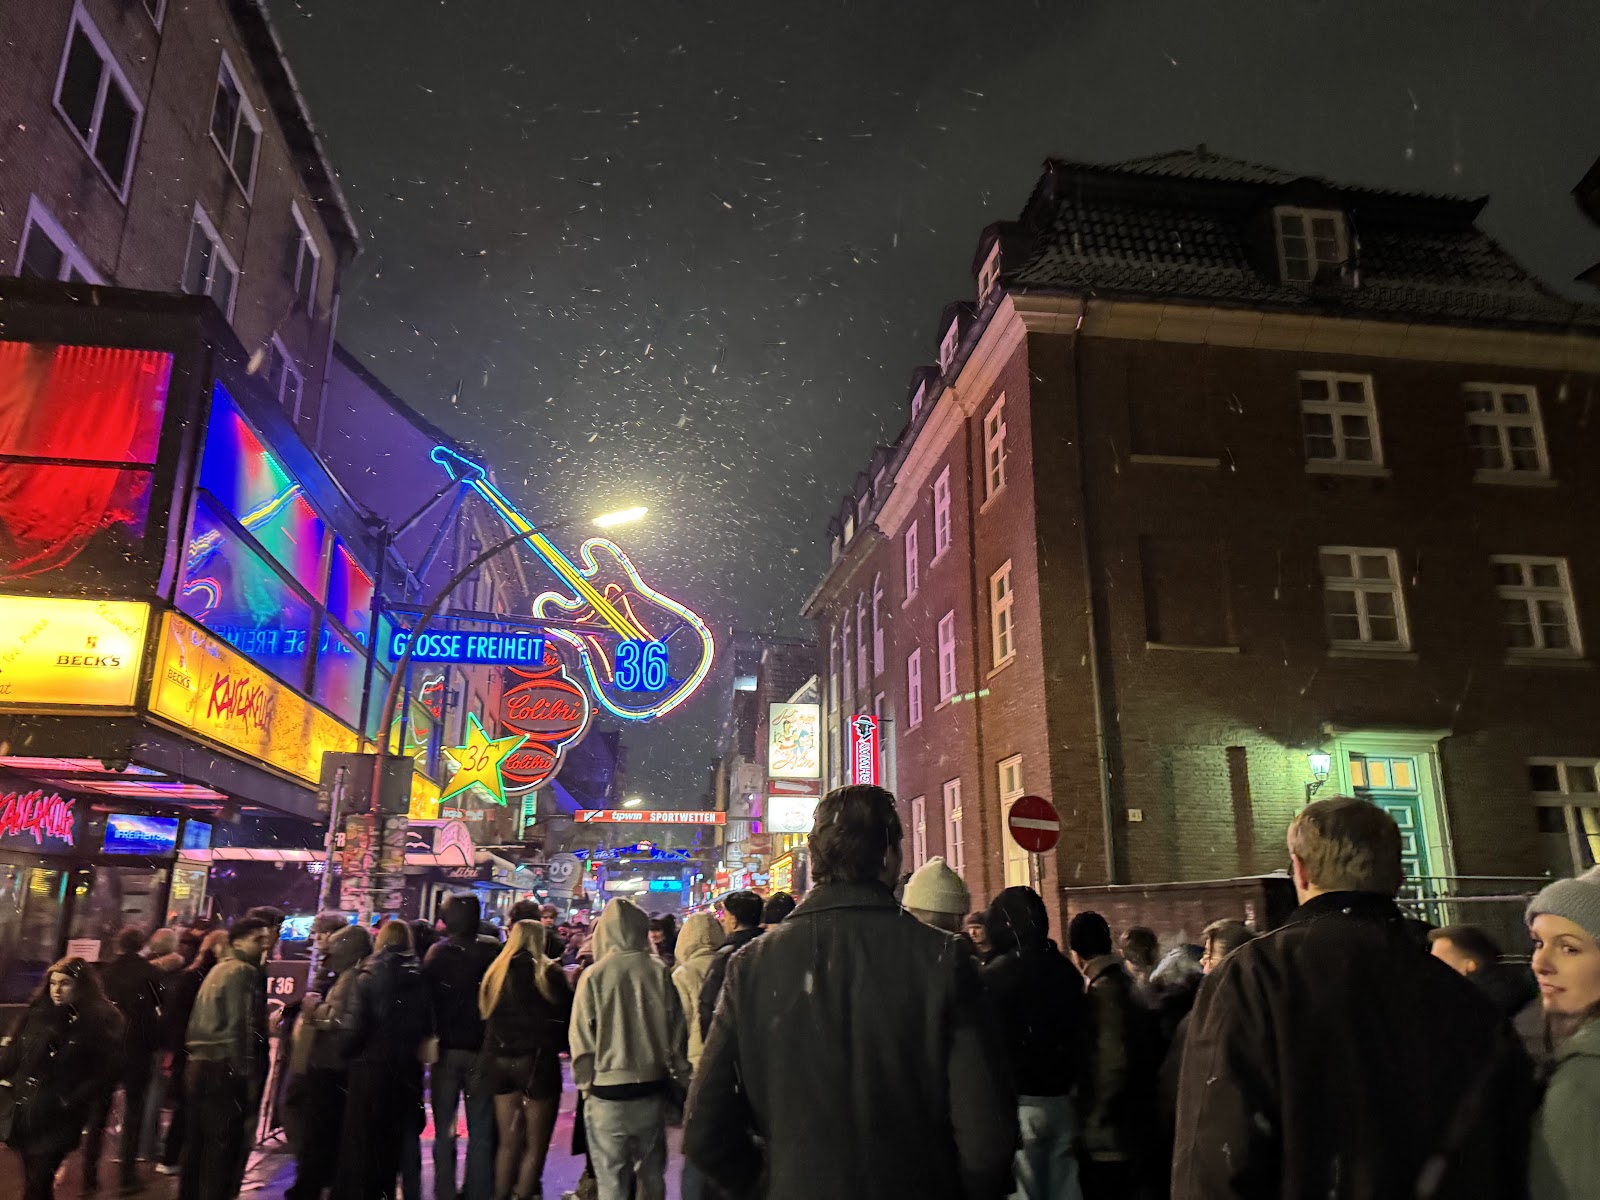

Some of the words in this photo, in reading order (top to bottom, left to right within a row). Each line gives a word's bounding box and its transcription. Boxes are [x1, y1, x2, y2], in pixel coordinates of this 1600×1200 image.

[393, 633, 461, 658] GOSSE
[467, 636, 543, 660] FREIHEIT
[56, 654, 121, 667] BECK'S
[615, 641, 668, 691] 36
[507, 695, 582, 721] Colibri
[463, 744, 491, 772] 36
[505, 753, 552, 769] Colibri
[611, 810, 643, 822] tipwin
[649, 811, 716, 823] SPORTWETTEN
[275, 976, 295, 995] 36
